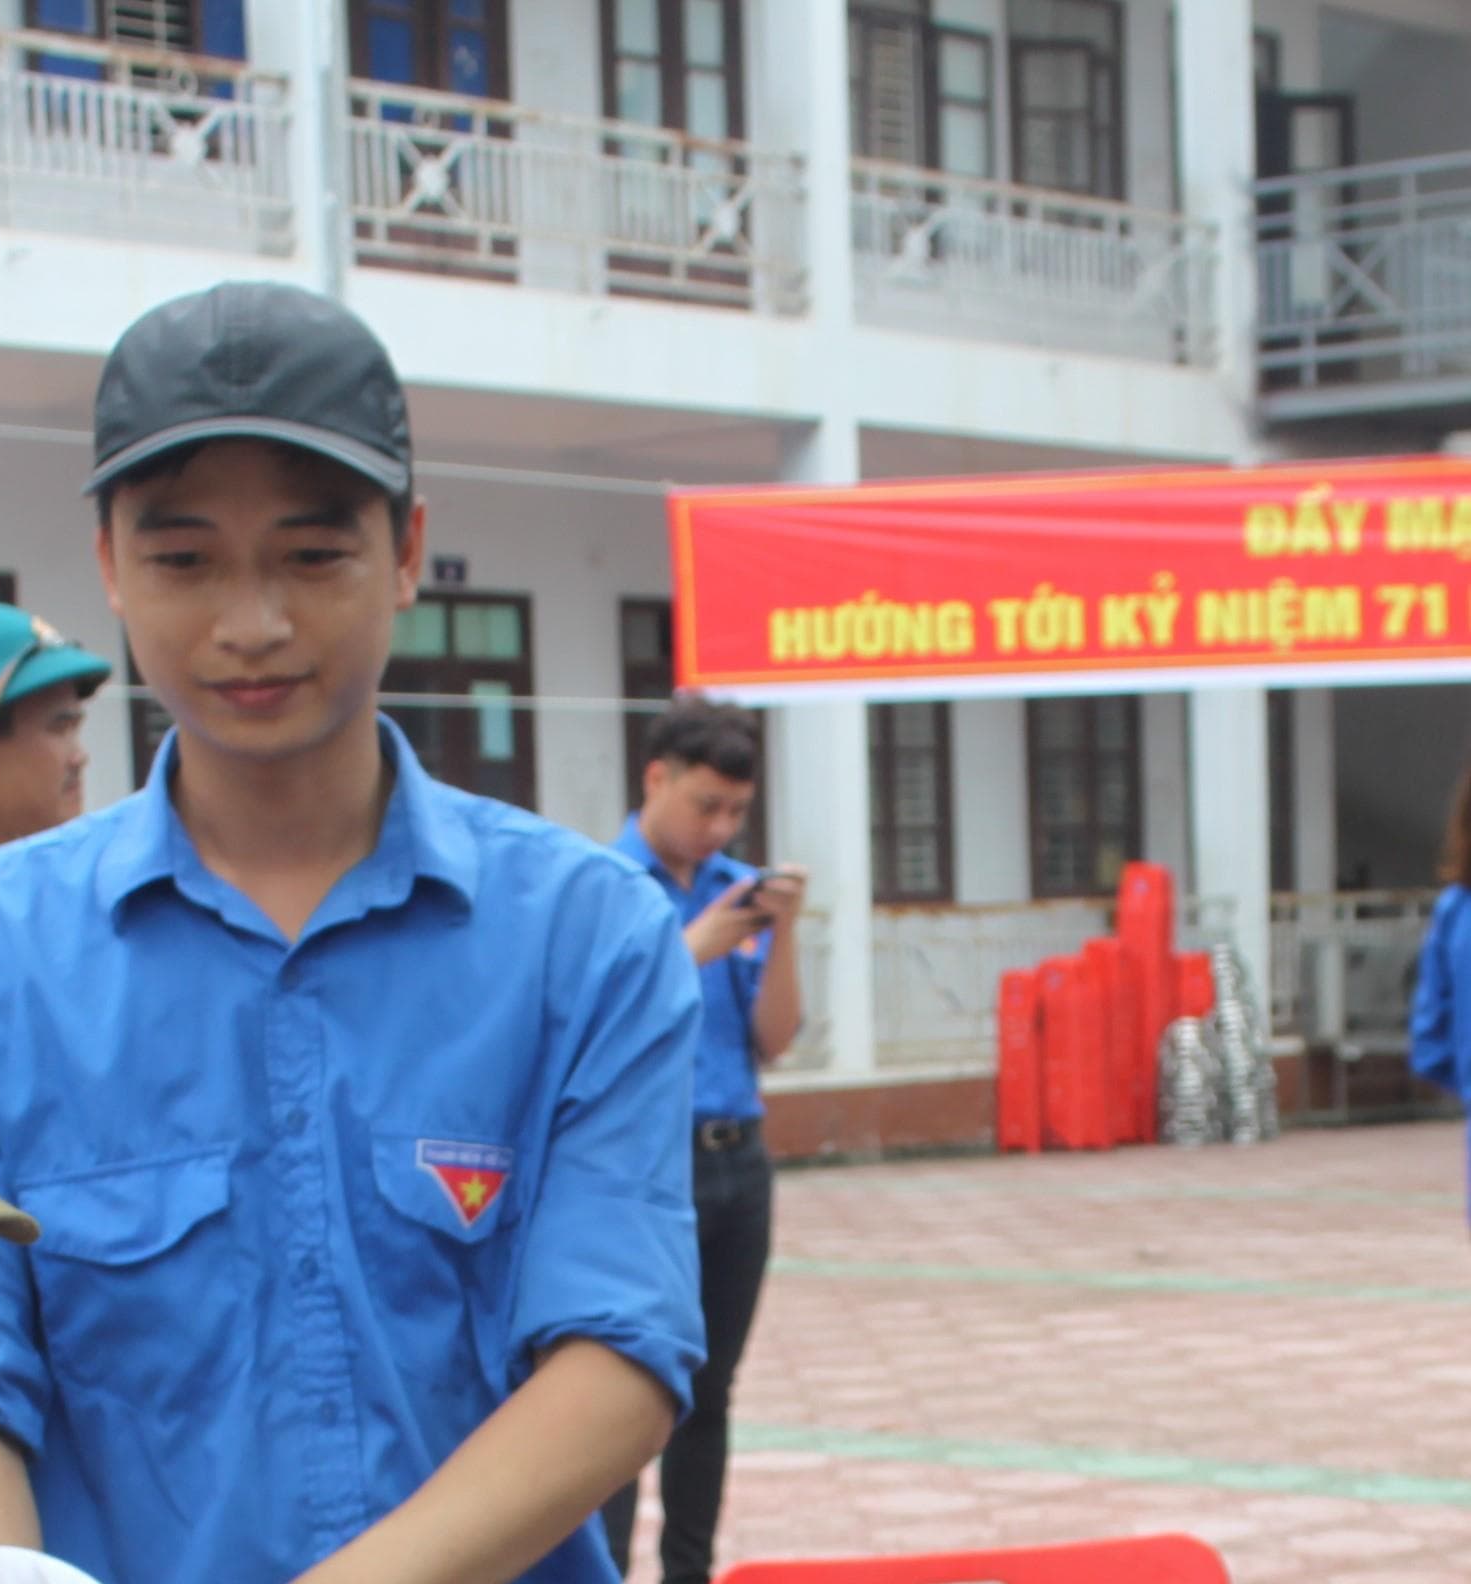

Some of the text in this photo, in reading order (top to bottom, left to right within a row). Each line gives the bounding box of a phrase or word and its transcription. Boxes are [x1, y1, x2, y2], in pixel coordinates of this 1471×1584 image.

[770, 572, 1447, 660] HƯỚNG TỚI KỶ NIỆM 71
